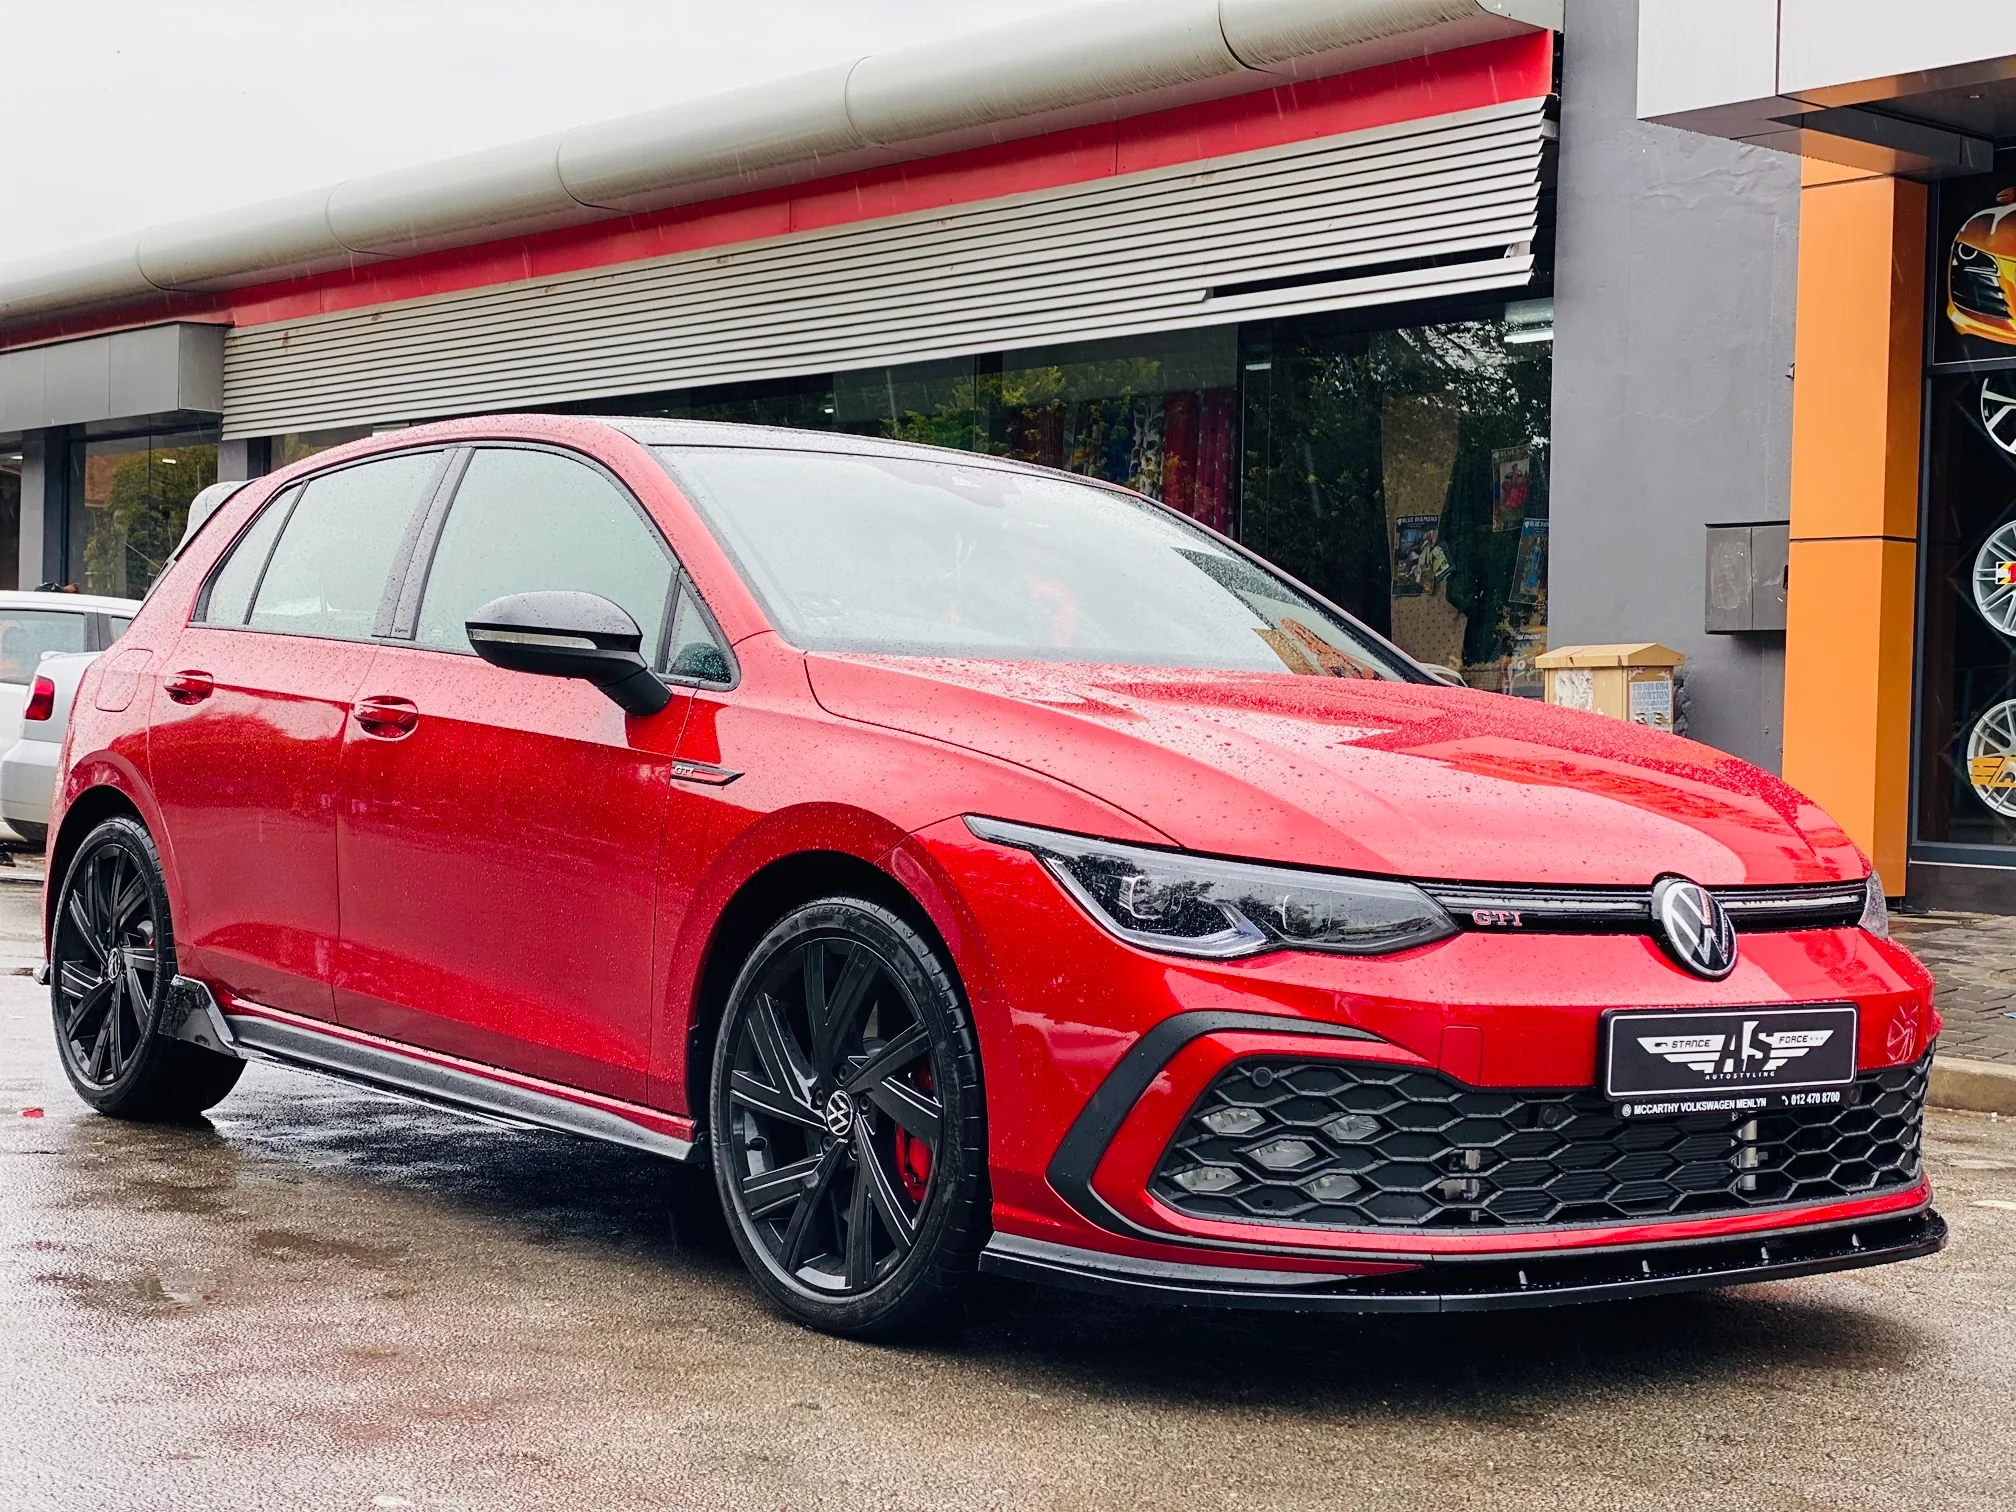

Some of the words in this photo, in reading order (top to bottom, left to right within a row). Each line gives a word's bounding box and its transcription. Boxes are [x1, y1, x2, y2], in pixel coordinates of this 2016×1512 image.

[1632, 691, 1669, 700] ABORTION
[674, 765, 695, 777] GTI
[1471, 909, 1523, 927] GTI
[1671, 1039, 1711, 1049] STANCE
[1778, 1034, 1809, 1044] FORCE
[1704, 1071, 1777, 1081] AUTOSTYLING
[1790, 1093, 1805, 1105] 012
[1806, 1092, 1820, 1105] 470
[1821, 1091, 1841, 1103] 8700
[1633, 1102, 1680, 1115] MCCARTHY
[1680, 1099, 1736, 1113] VOLKSWAGEN
[1736, 1098, 1767, 1110] MENLYN
